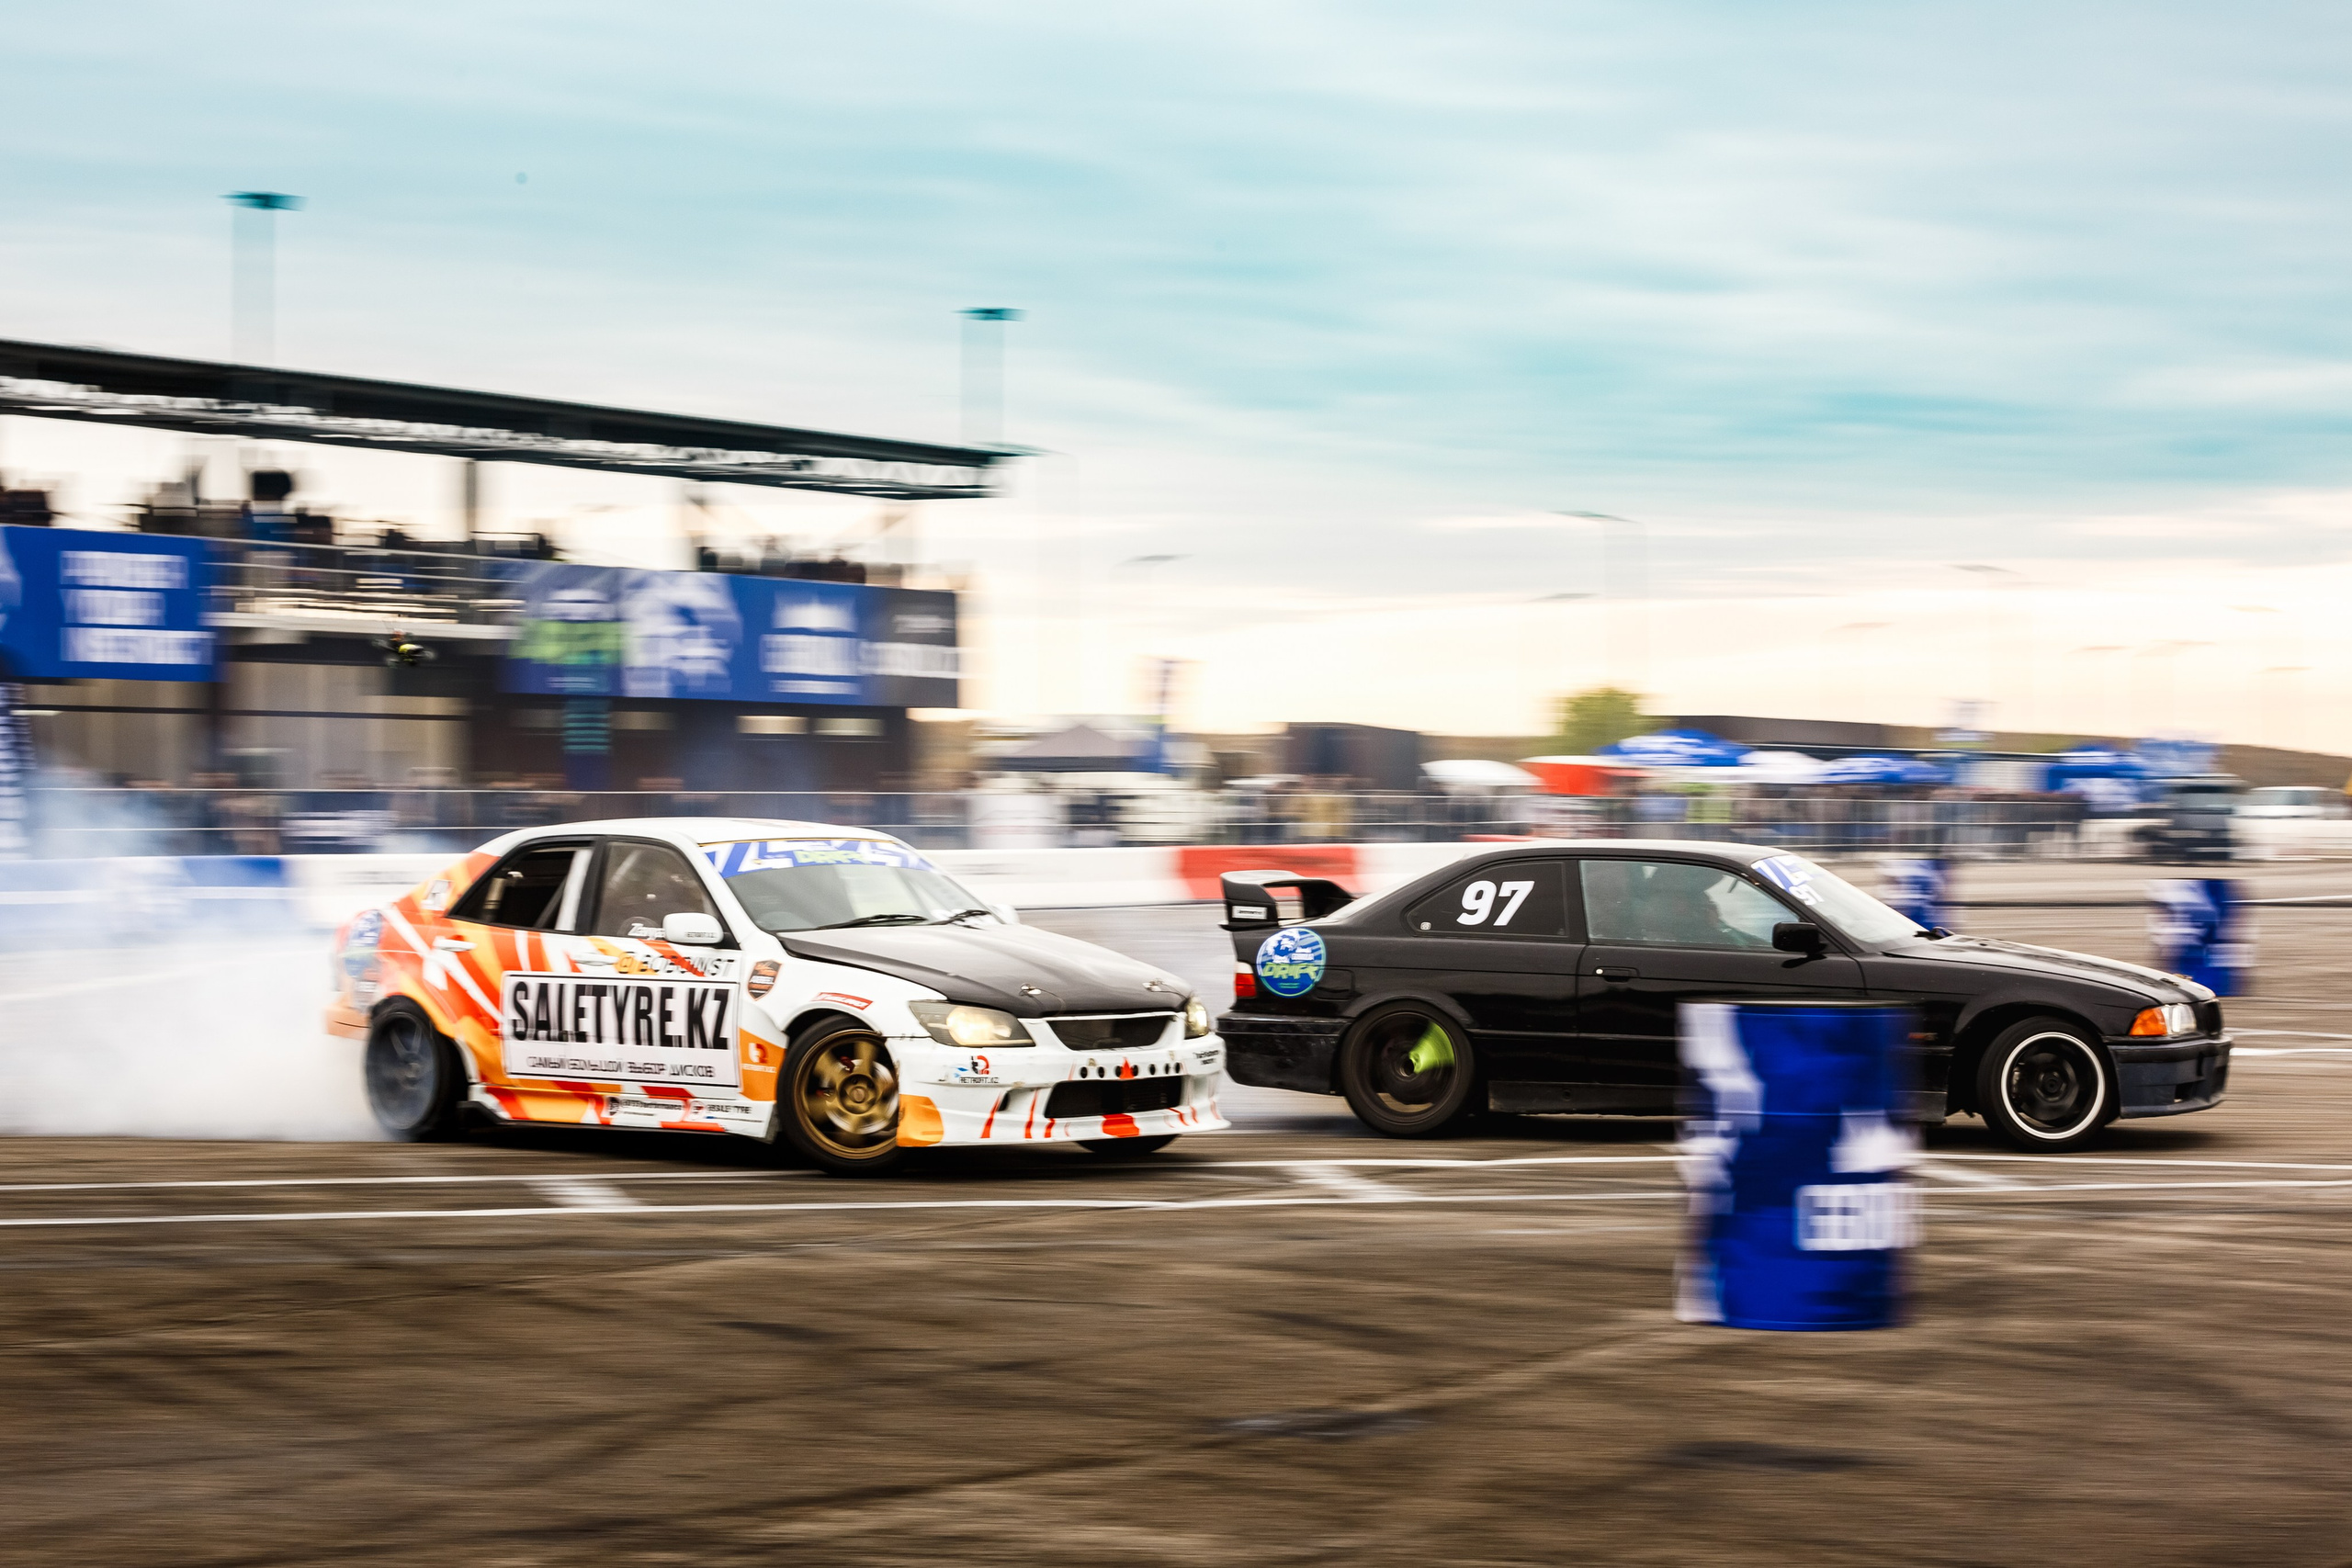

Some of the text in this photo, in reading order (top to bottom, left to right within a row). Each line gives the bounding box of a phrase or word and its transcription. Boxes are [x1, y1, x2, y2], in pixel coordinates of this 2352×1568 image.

[1456, 880, 1535, 926] 97
[1260, 962, 1319, 980] DRIFT
[512, 981, 730, 1050] SALETYRE.KZ
